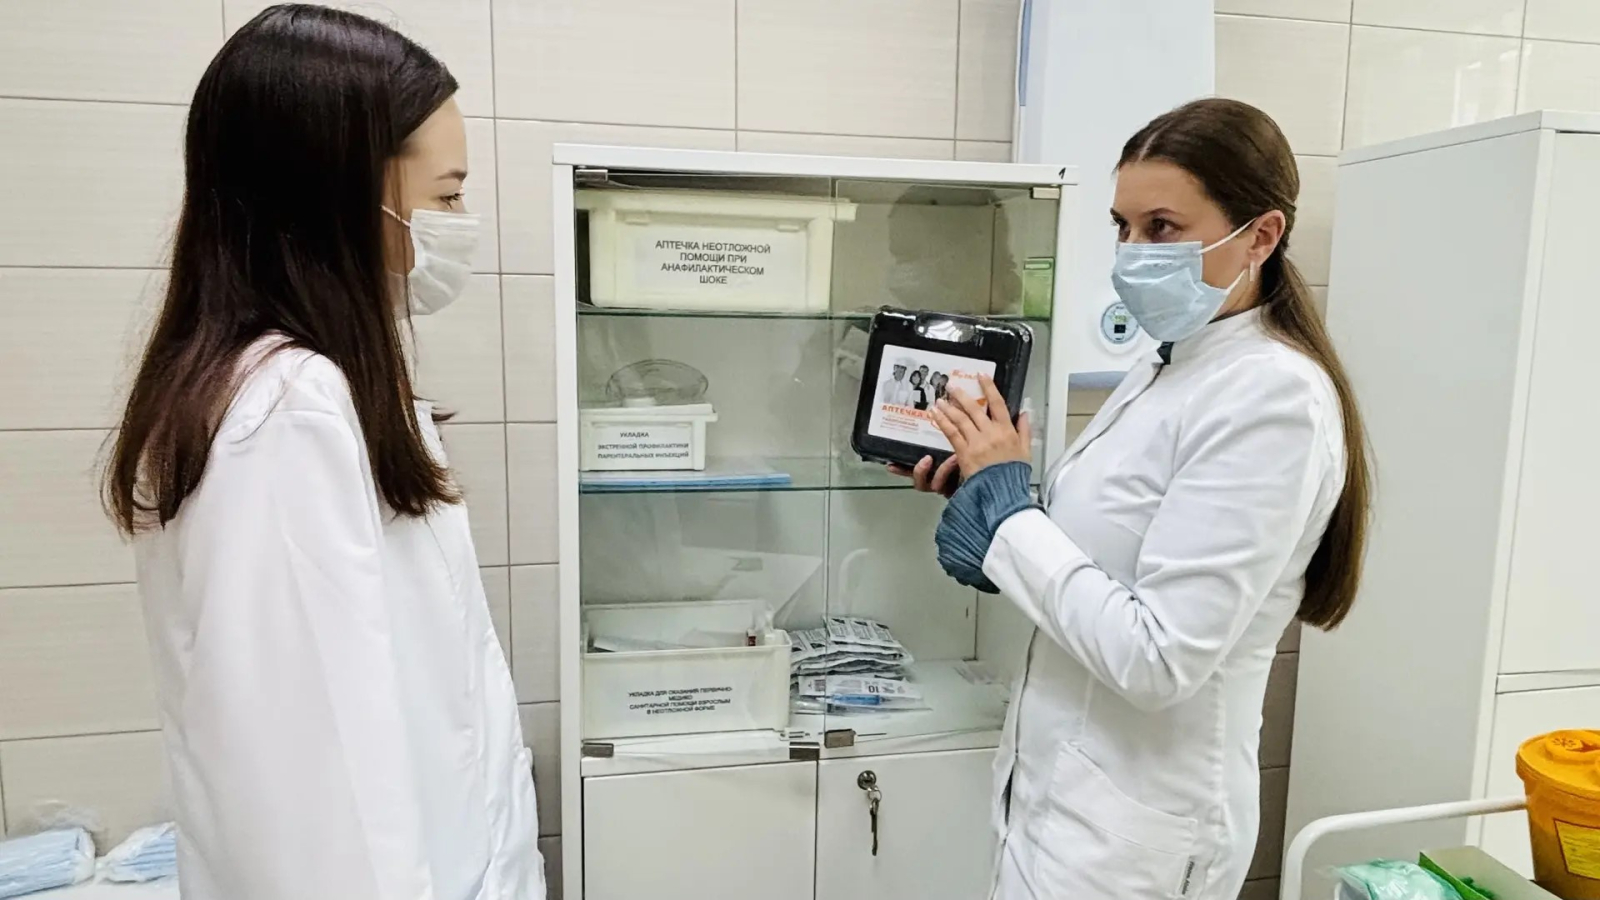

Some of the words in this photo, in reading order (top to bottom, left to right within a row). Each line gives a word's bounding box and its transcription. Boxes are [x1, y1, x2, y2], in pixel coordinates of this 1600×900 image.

[655, 240, 700, 251] АПТЕЧКА
[702, 242, 771, 254] НЕОТЛОЖНОЙ
[680, 252, 725, 264] ПОМОЩИ
[727, 254, 747, 264] ПРИ
[660, 263, 764, 276] АНАФИЛАКТИЧЕСКОМ
[699, 275, 728, 284] ШОКЕ
[881, 404, 924, 418] АПТЕЧКА
[655, 451, 689, 459] ИНЪЕКЦИЙ
[629, 702, 669, 710] САНИТАРНОЙ
[670, 700, 697, 708] ПОМОЩИ
[698, 698, 731, 706] ВЗРОСЛЫМ
[652, 706, 693, 714] НЕОТЛОЖНОЙ
